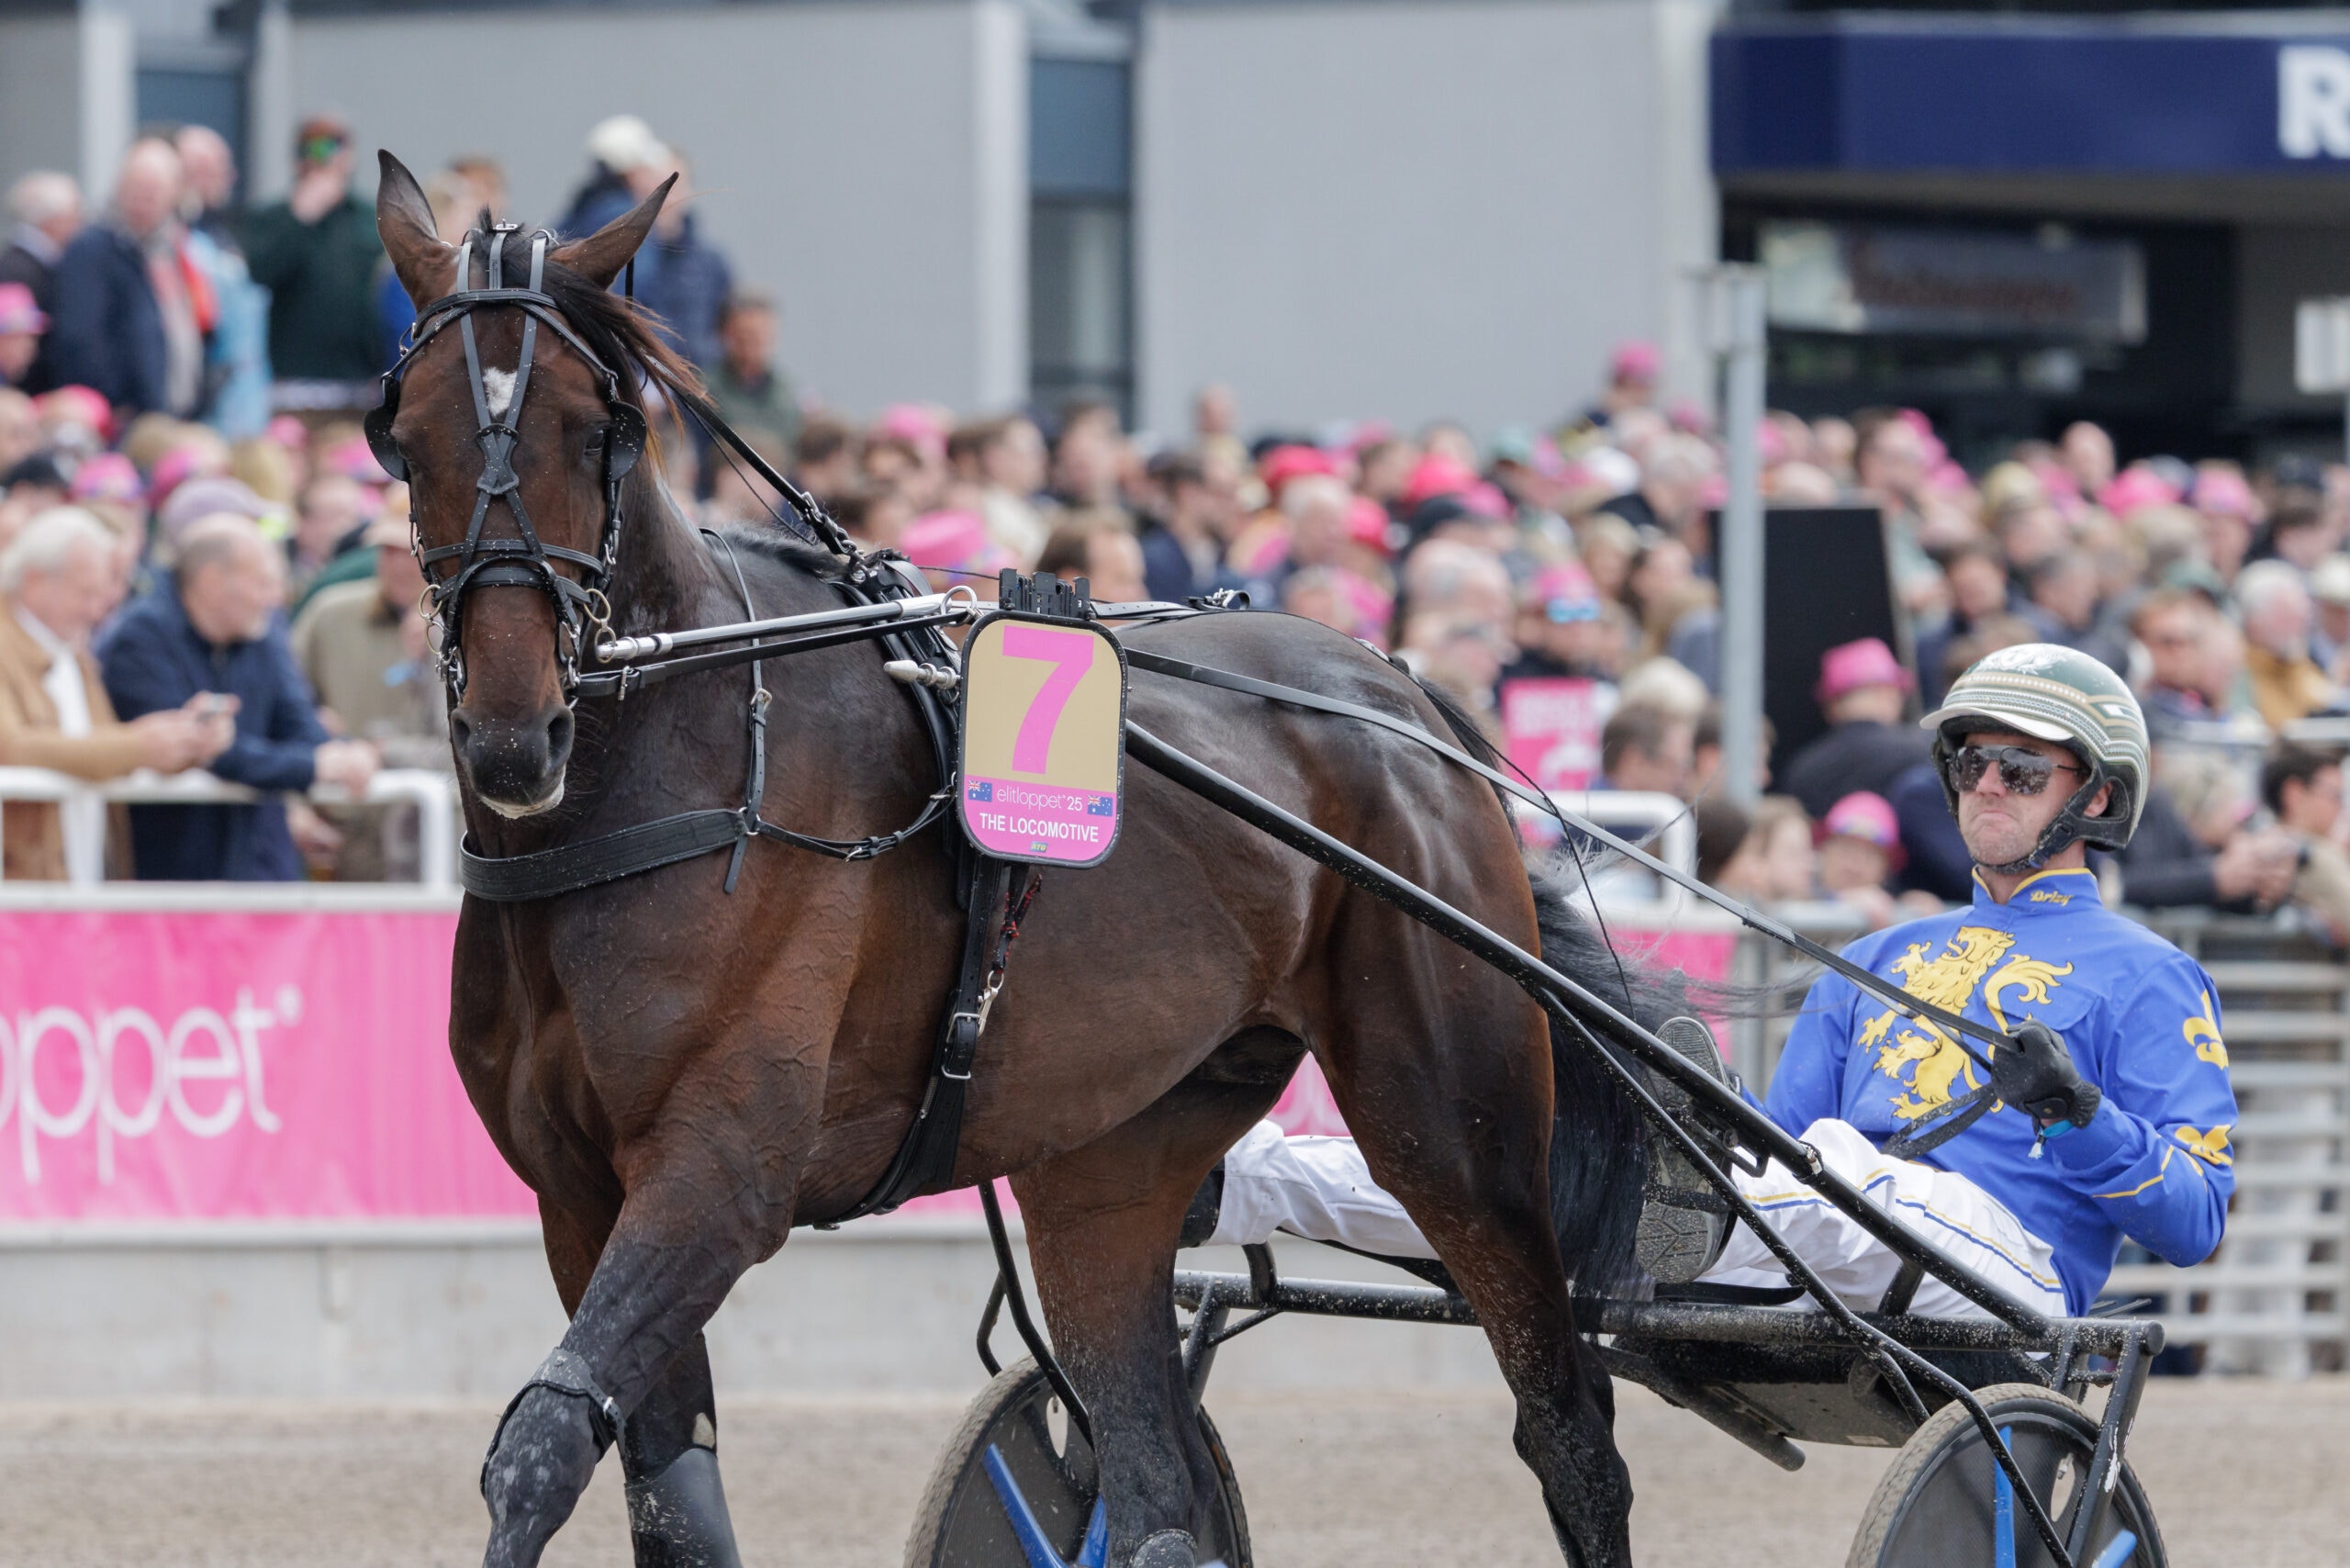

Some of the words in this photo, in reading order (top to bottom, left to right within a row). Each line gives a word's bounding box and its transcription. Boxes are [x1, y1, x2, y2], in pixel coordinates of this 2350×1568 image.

[1002, 625, 1094, 775] 7
[979, 812, 1006, 832] THE
[1010, 816, 1100, 843] LOCOMOTIVE
[0, 984, 283, 1186] ppet
